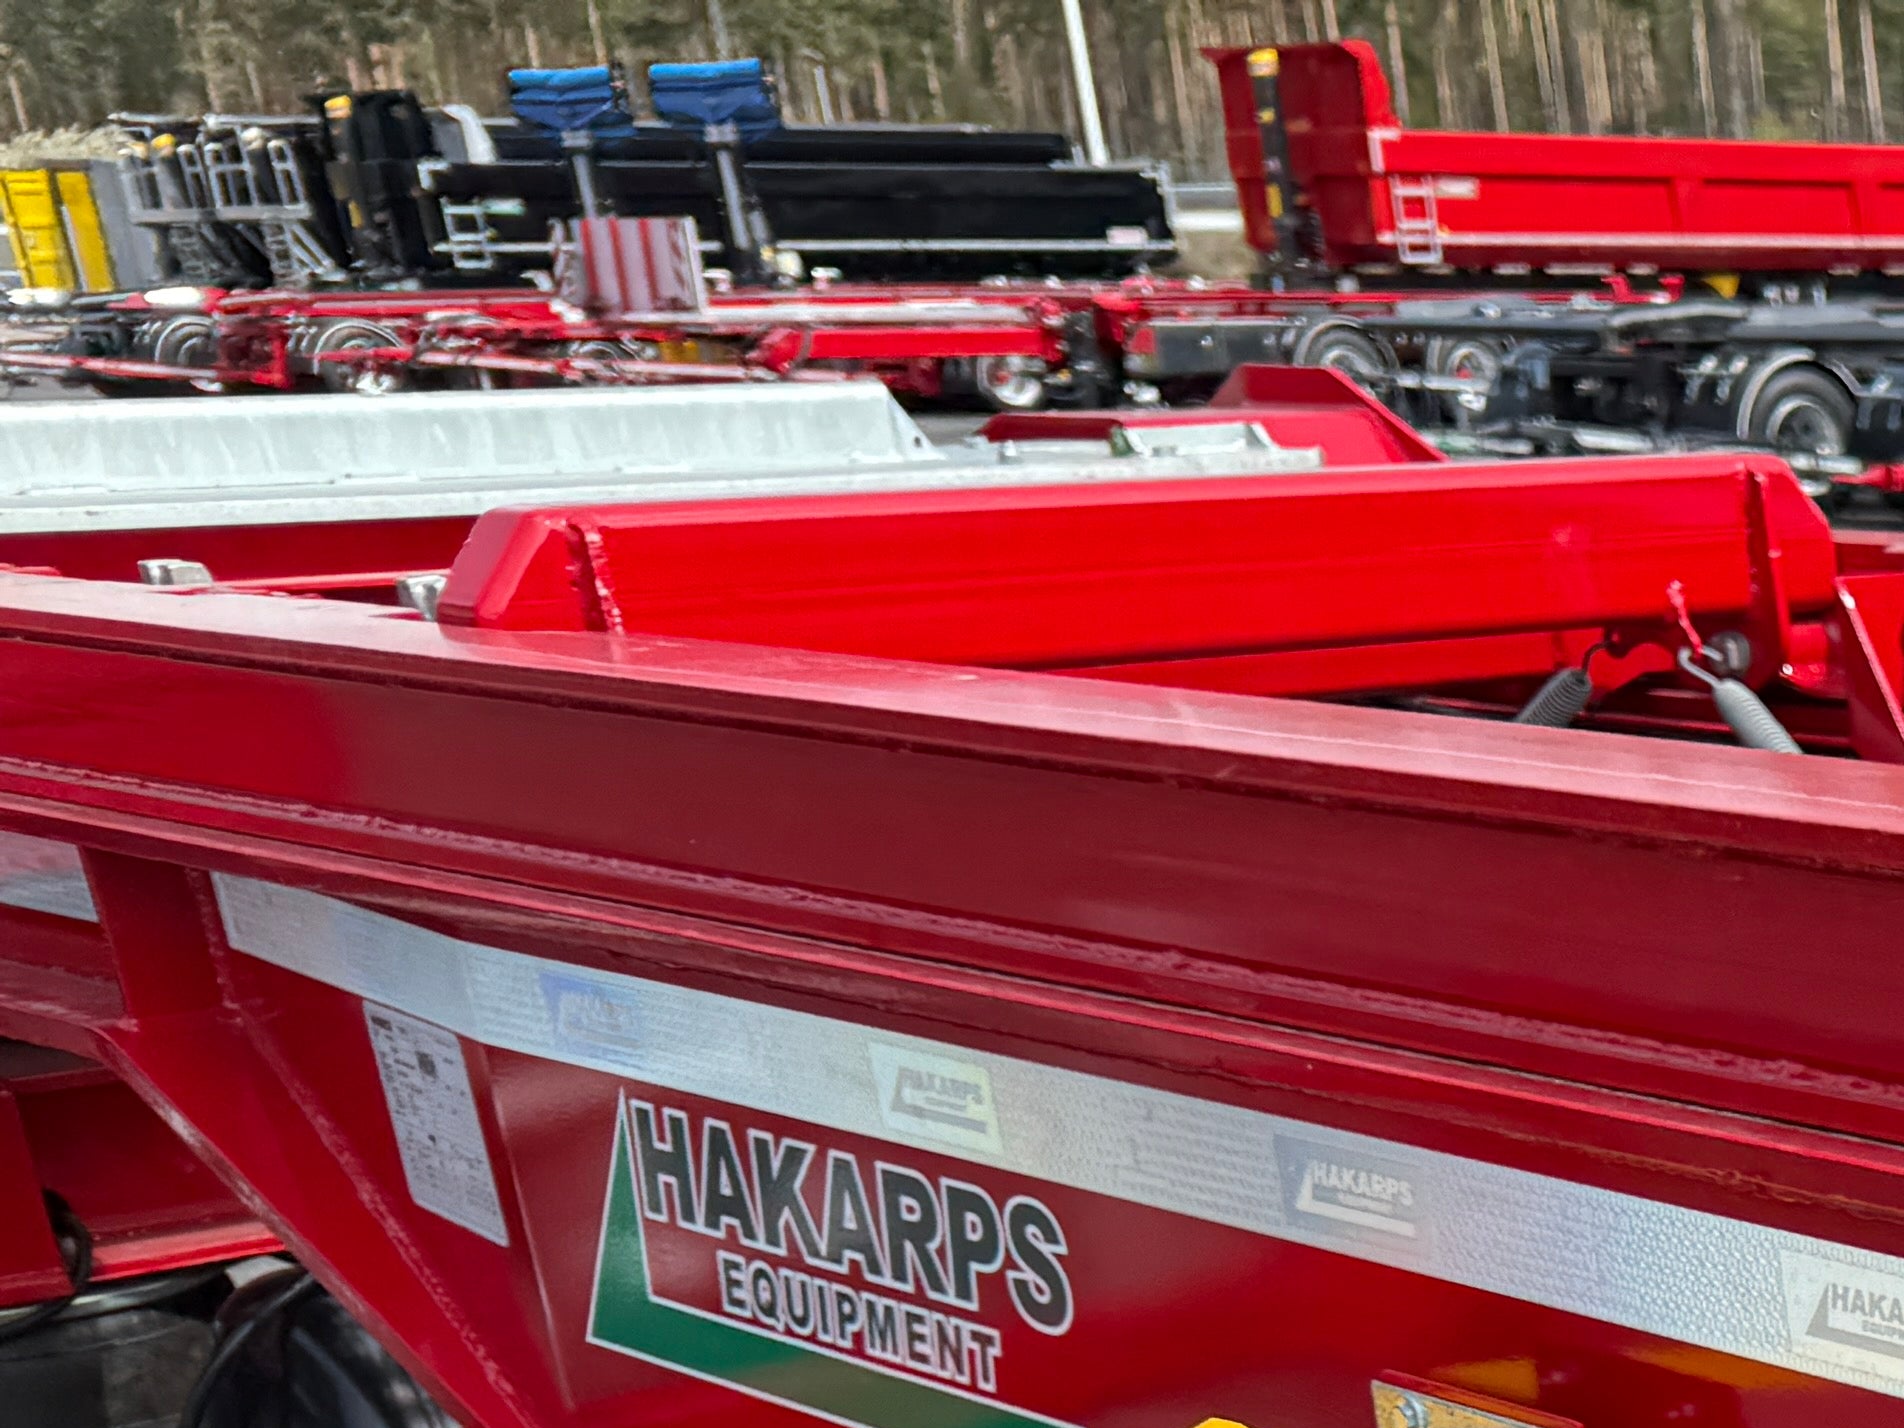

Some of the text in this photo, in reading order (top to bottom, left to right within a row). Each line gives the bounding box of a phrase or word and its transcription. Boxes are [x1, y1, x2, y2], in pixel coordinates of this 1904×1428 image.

[630, 1098, 1074, 1336] HAKARPS
[1313, 1161, 1414, 1206] HAKARPS
[717, 1250, 1003, 1393] EQUIPMENT
